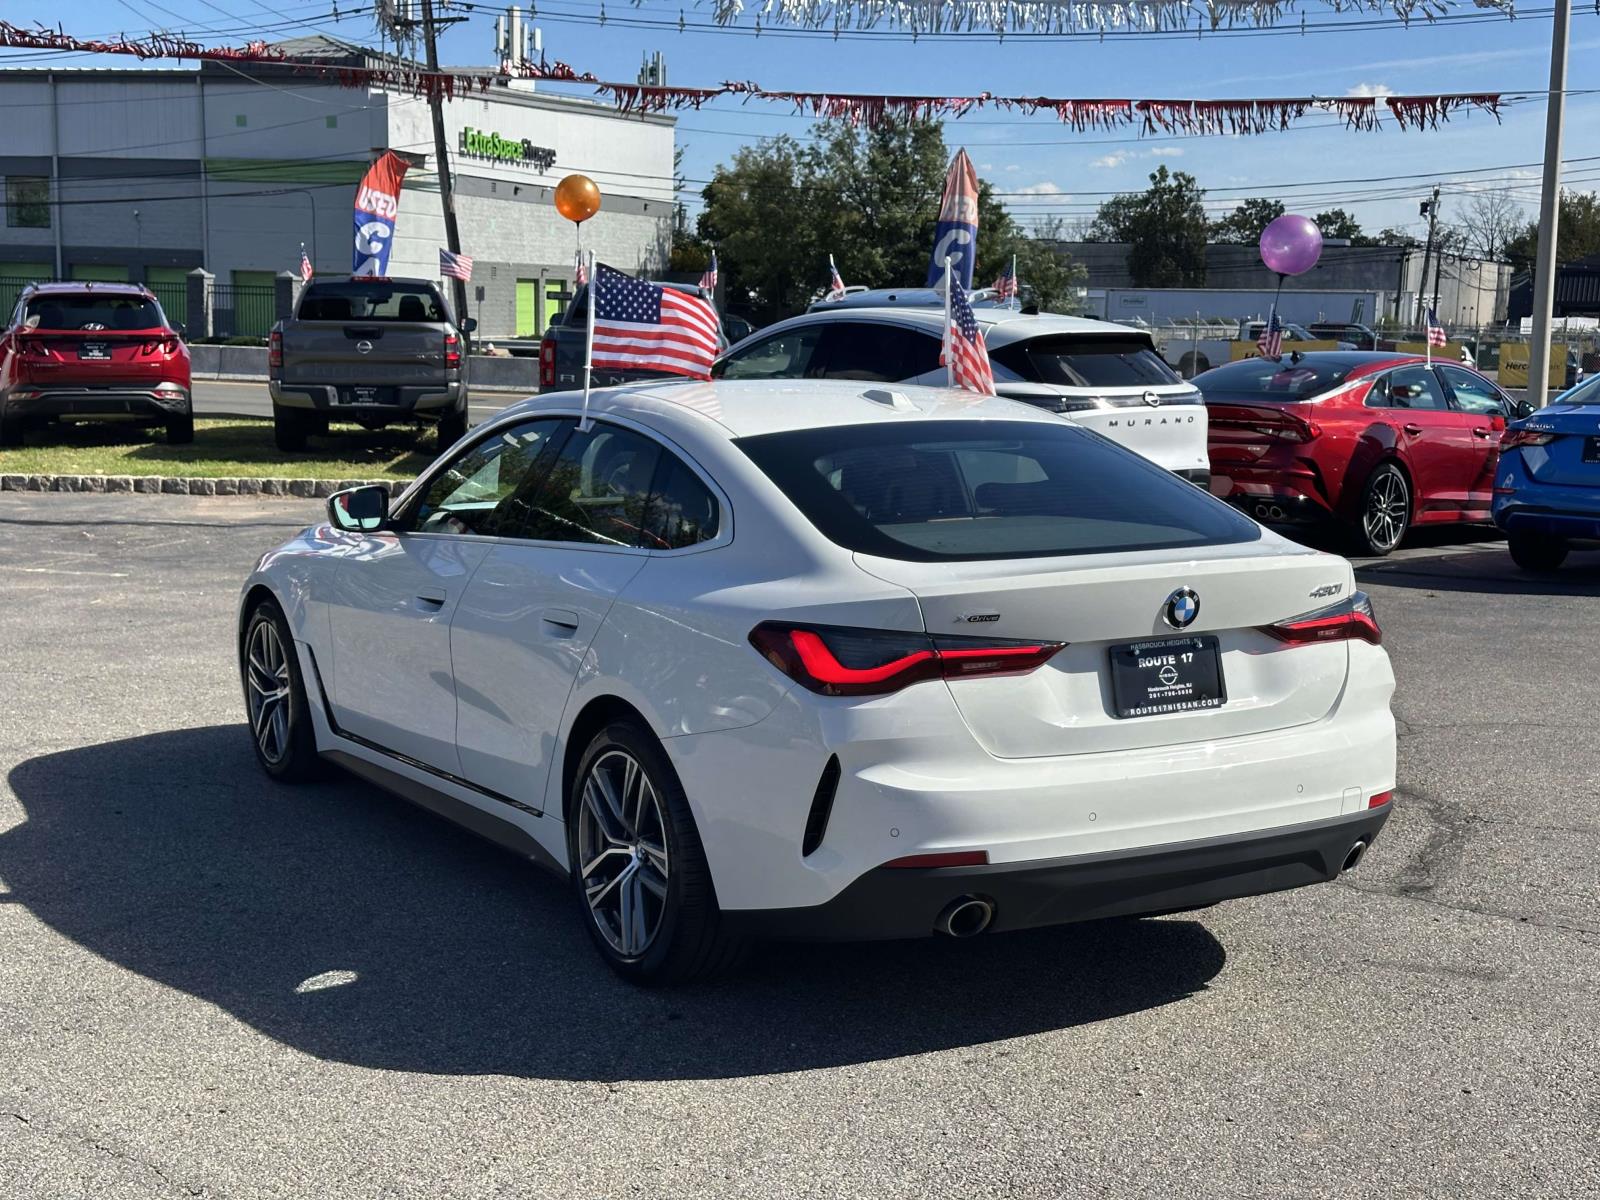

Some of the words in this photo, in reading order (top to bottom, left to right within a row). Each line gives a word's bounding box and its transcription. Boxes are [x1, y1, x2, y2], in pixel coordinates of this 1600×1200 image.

[358, 185, 397, 219] USED
[1108, 415, 1194, 427] MURANO
[1138, 654, 1176, 668] ROUTE
[1180, 652, 1194, 663] 17
[1130, 699, 1219, 716] ROUTE17NISSAN.COM
